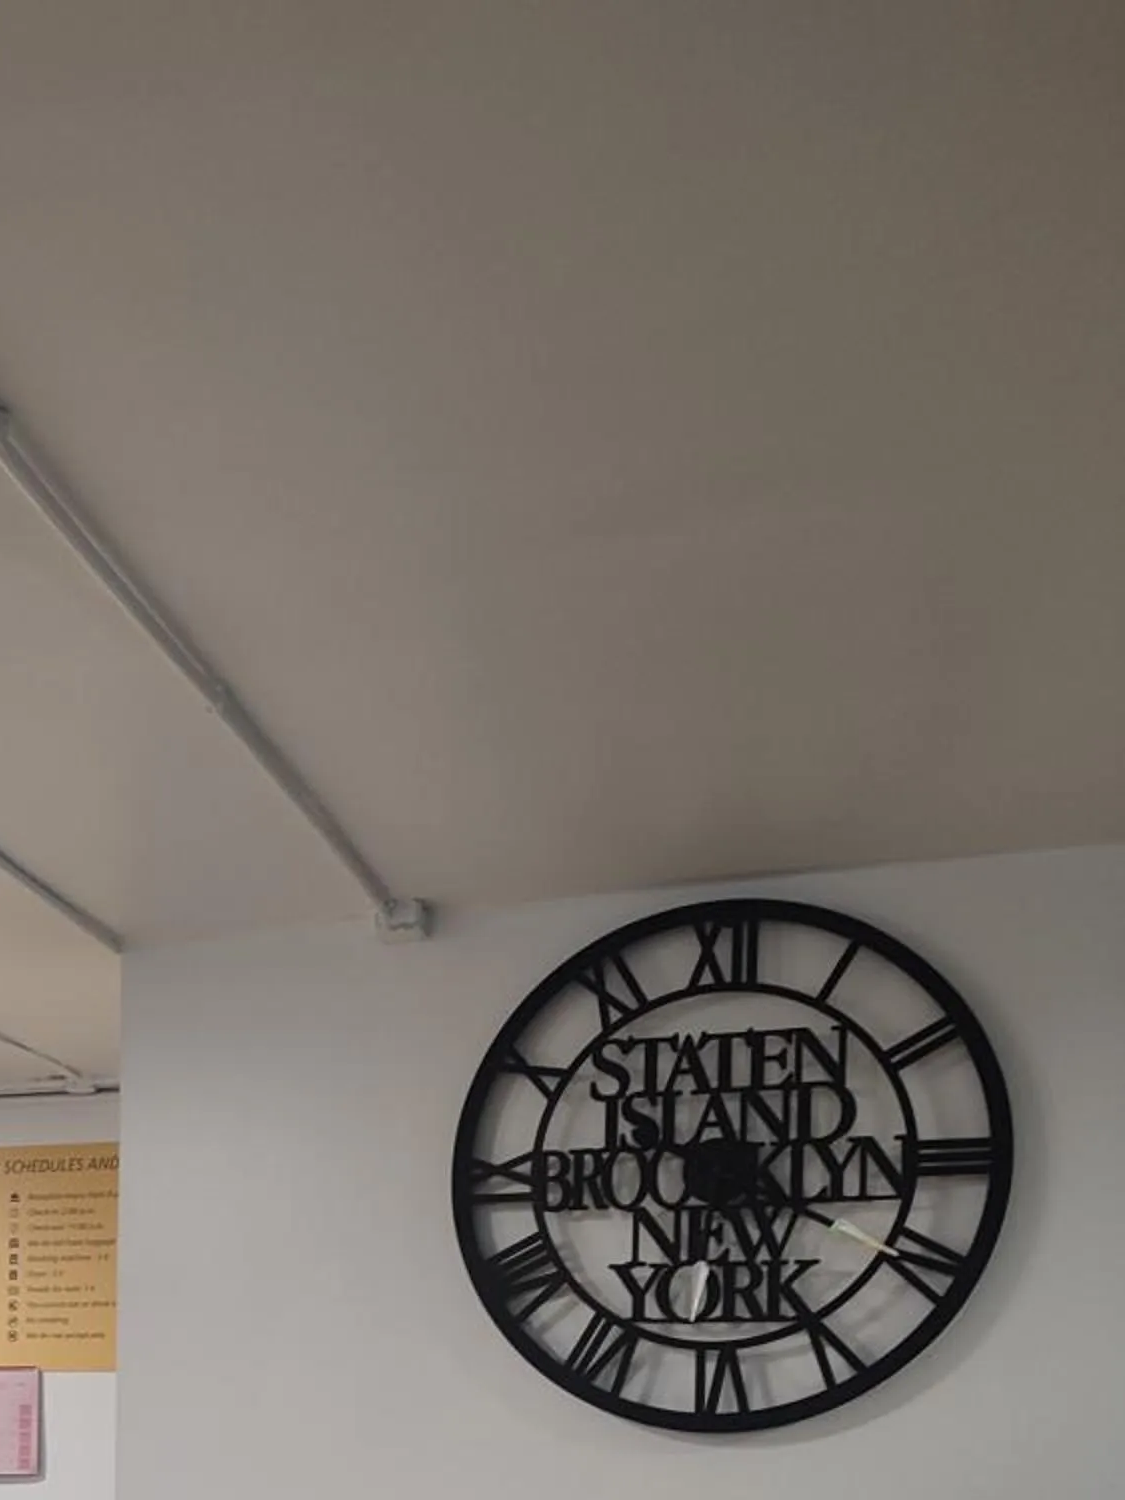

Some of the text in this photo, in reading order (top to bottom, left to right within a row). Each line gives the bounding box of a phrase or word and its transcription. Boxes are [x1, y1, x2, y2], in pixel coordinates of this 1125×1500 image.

[590, 1026, 848, 1101] STATEN
[603, 1082, 857, 1152] ISLAND
[4, 1157, 84, 1174] SCHEDULES
[87, 1154, 119, 1170] AND
[541, 1135, 909, 1211] BROOKLYN
[632, 1202, 802, 1265] NEW
[609, 1257, 821, 1323] YORK
